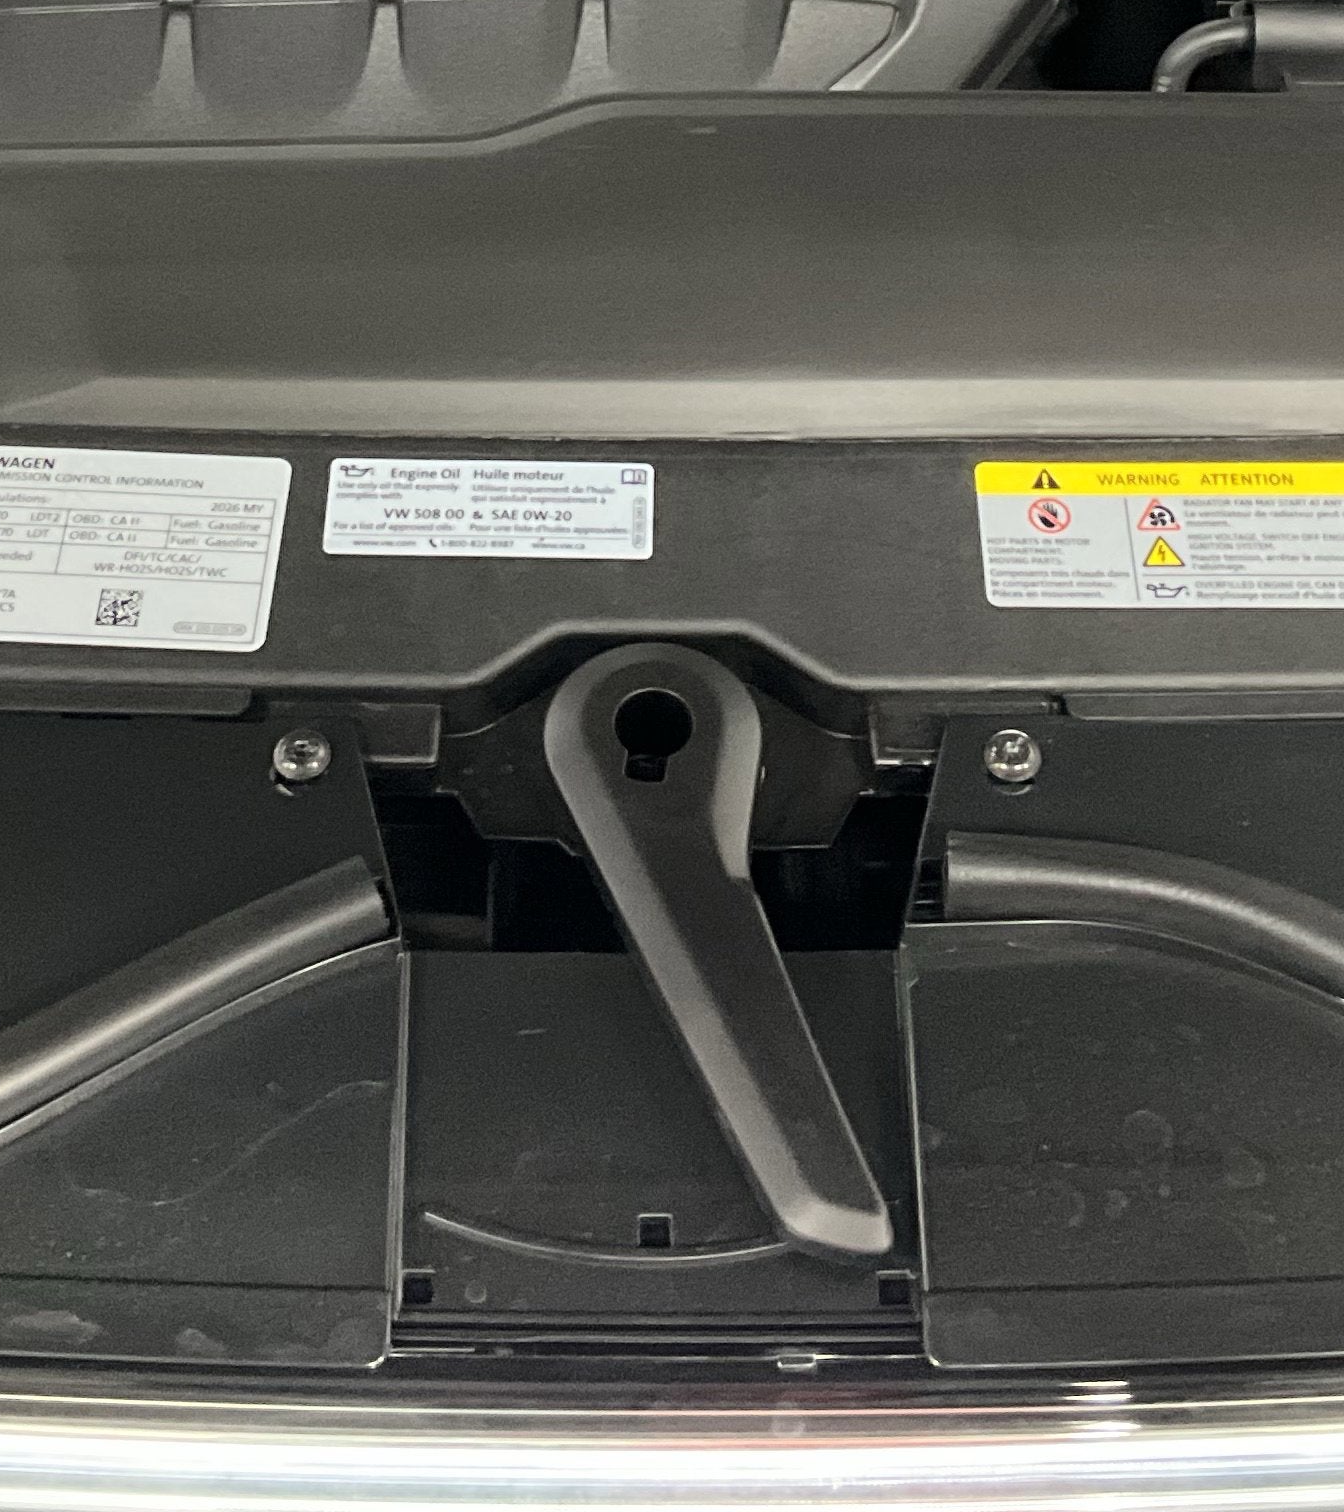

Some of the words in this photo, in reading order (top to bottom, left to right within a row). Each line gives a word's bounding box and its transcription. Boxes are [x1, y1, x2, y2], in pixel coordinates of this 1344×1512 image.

[55, 473, 112, 485] CONTROL
[115, 476, 205, 489] INFORMATION
[390, 468, 437, 482] Engine
[440, 467, 461, 479] Oil
[473, 468, 511, 480] Huile
[513, 469, 565, 482] moteur
[1097, 473, 1180, 486] WARNING
[1200, 472, 1294, 486] ATTENTION
[210, 501, 241, 512] 2026
[243, 503, 265, 513] MY
[384, 508, 410, 519] VW
[415, 508, 441, 519] 508
[445, 508, 465, 519] 00
[472, 511, 483, 519] &
[491, 509, 518, 520] SAE
[523, 509, 572, 521] 0W-20
[173, 519, 202, 529] Fuel:
[208, 520, 261, 531] Gasoline
[170, 535, 199, 546] Fuel:
[205, 536, 258, 548] Gasoline
